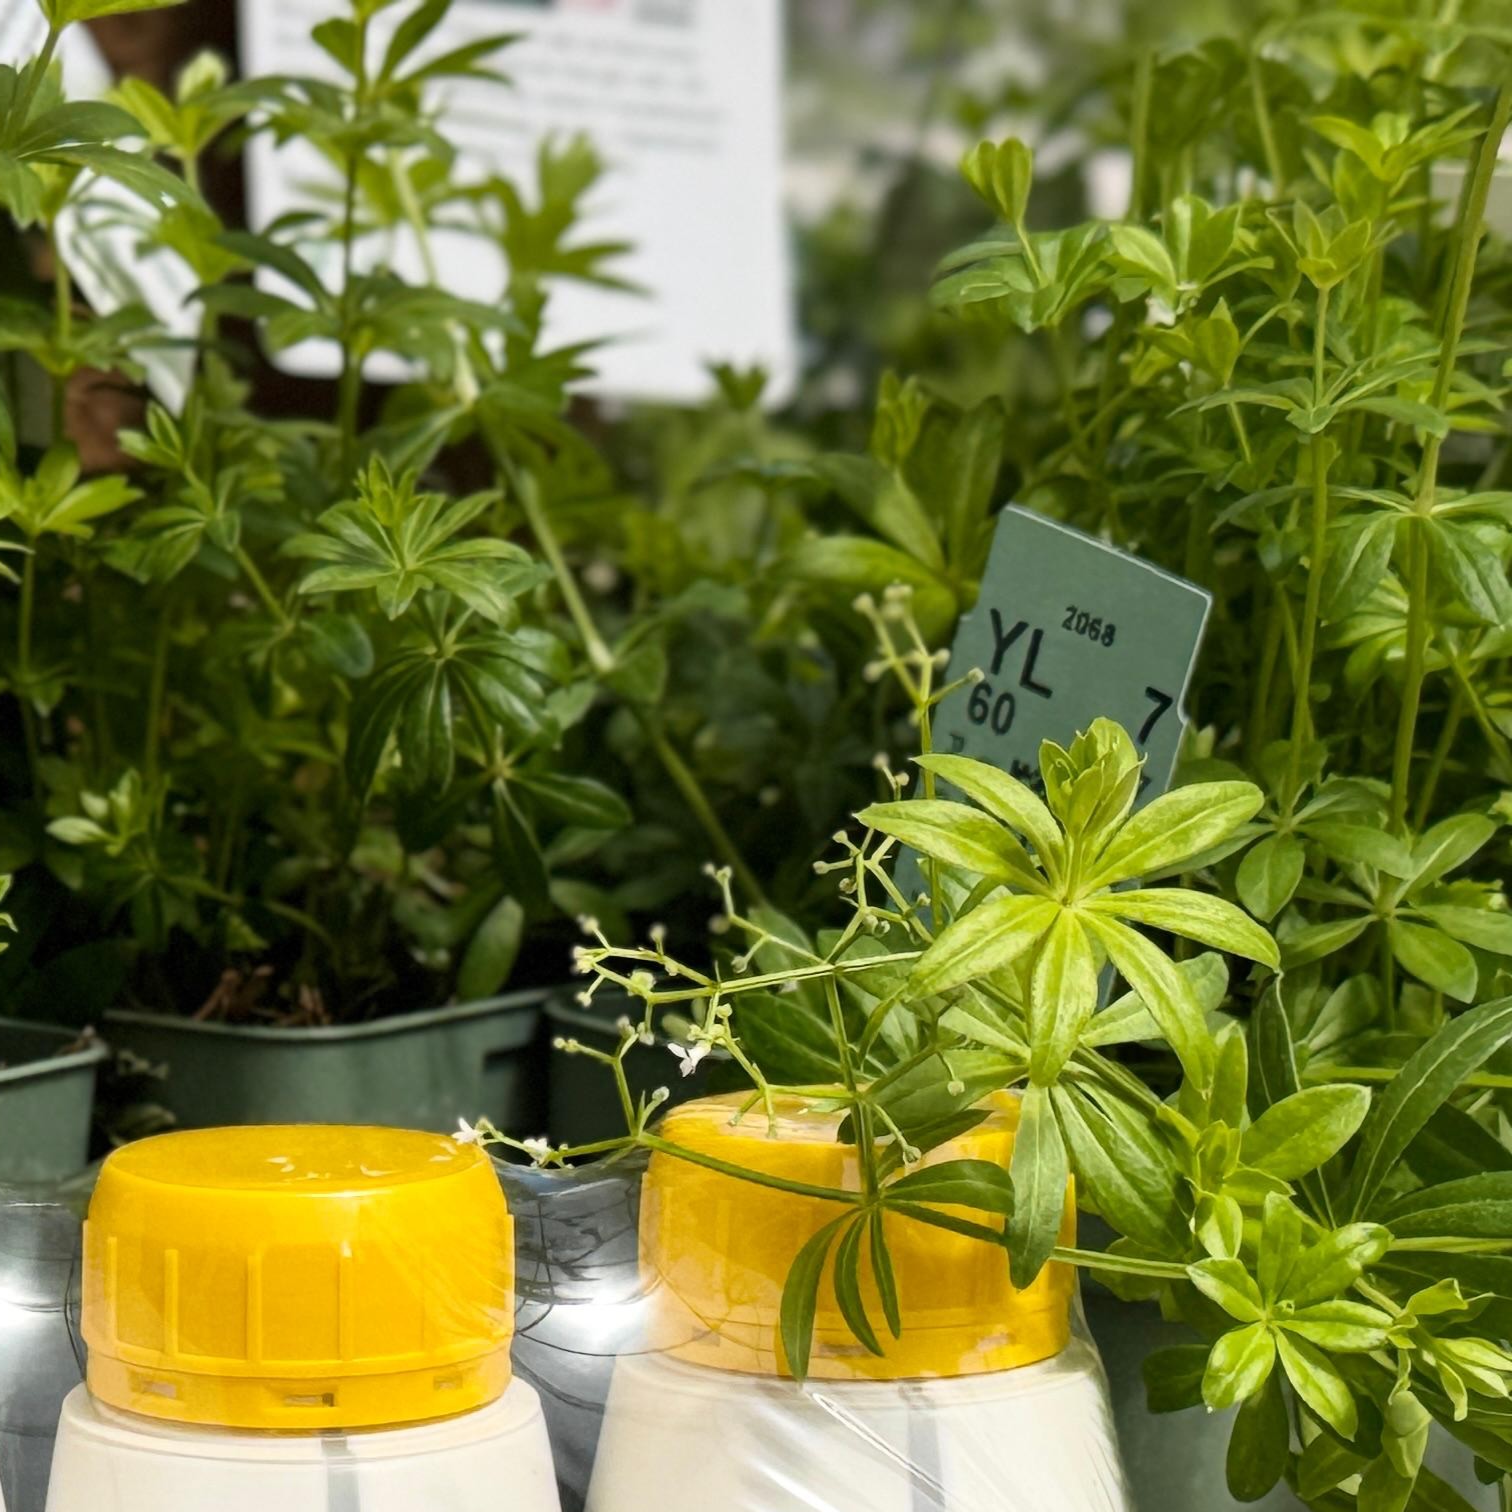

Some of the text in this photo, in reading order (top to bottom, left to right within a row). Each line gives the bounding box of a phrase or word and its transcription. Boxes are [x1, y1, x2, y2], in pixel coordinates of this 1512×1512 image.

[989, 607, 1053, 699] YL
[1060, 604, 1117, 648] 2068
[967, 682, 1016, 736] 60
[1138, 686, 1173, 744] 7
